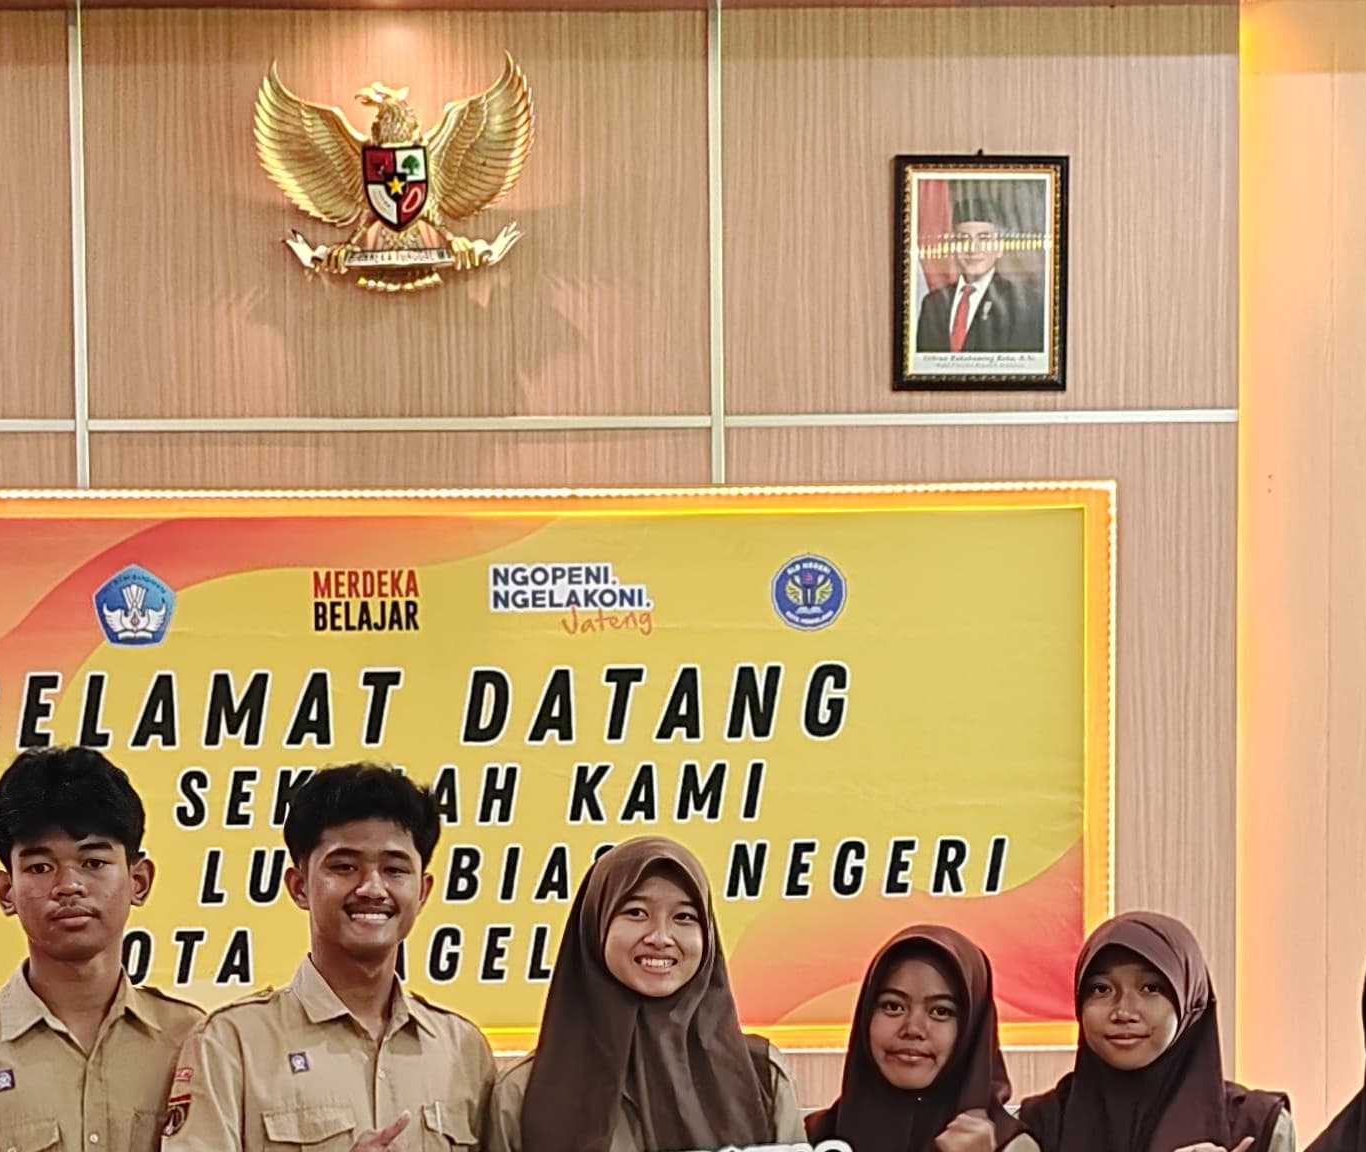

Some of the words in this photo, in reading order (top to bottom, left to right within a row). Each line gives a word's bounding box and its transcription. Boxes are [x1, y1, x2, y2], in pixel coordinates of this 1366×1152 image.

[312, 569, 420, 599] MERDEKA
[492, 566, 618, 586] NGOPENI.
[492, 588, 651, 609] NGELAKONI.
[313, 600, 420, 632] BELAJAR
[561, 606, 653, 635] Jateng
[461, 662, 850, 744] DATANG
[175, 765, 519, 828] SEKAH
[567, 760, 766, 823] KAMI
[724, 836, 1009, 898] NEGERI
[122, 928, 253, 986] OTA
